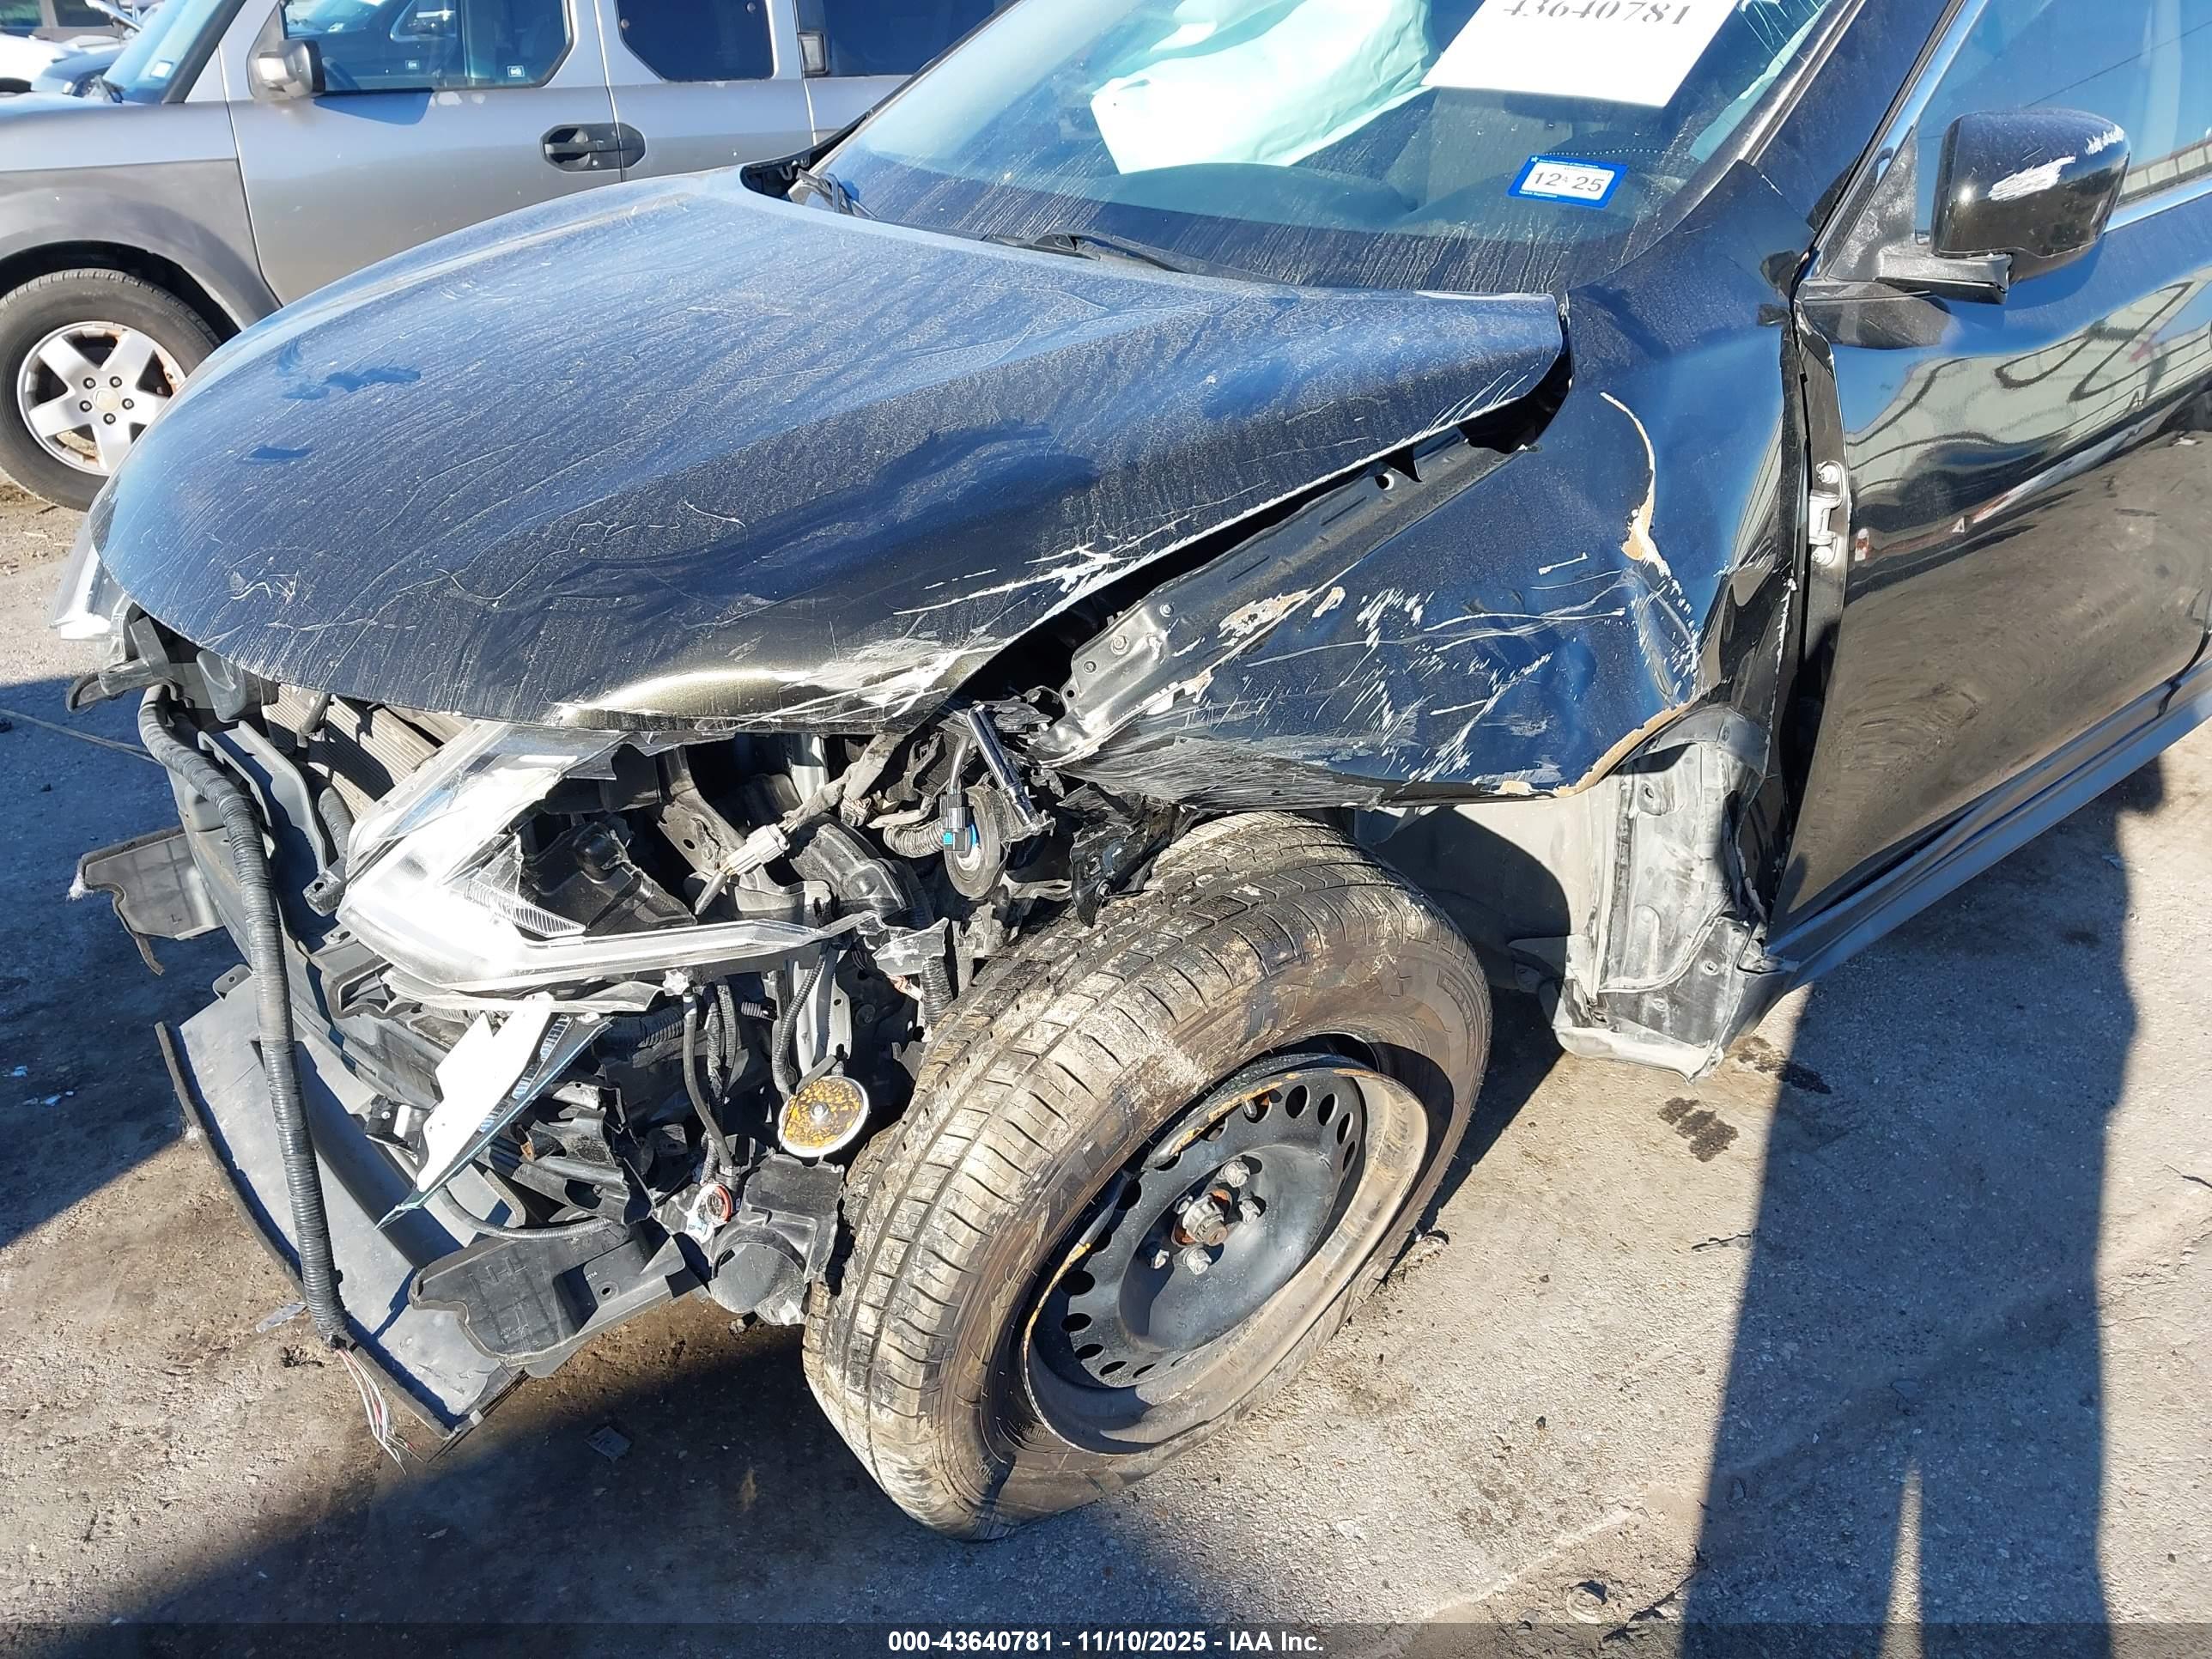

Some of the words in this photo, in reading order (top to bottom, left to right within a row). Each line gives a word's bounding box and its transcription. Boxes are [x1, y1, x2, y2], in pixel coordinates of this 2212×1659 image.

[1504, 0, 1691, 25] 43640781
[1534, 171, 1562, 187] 12
[1571, 175, 1605, 192] 25
